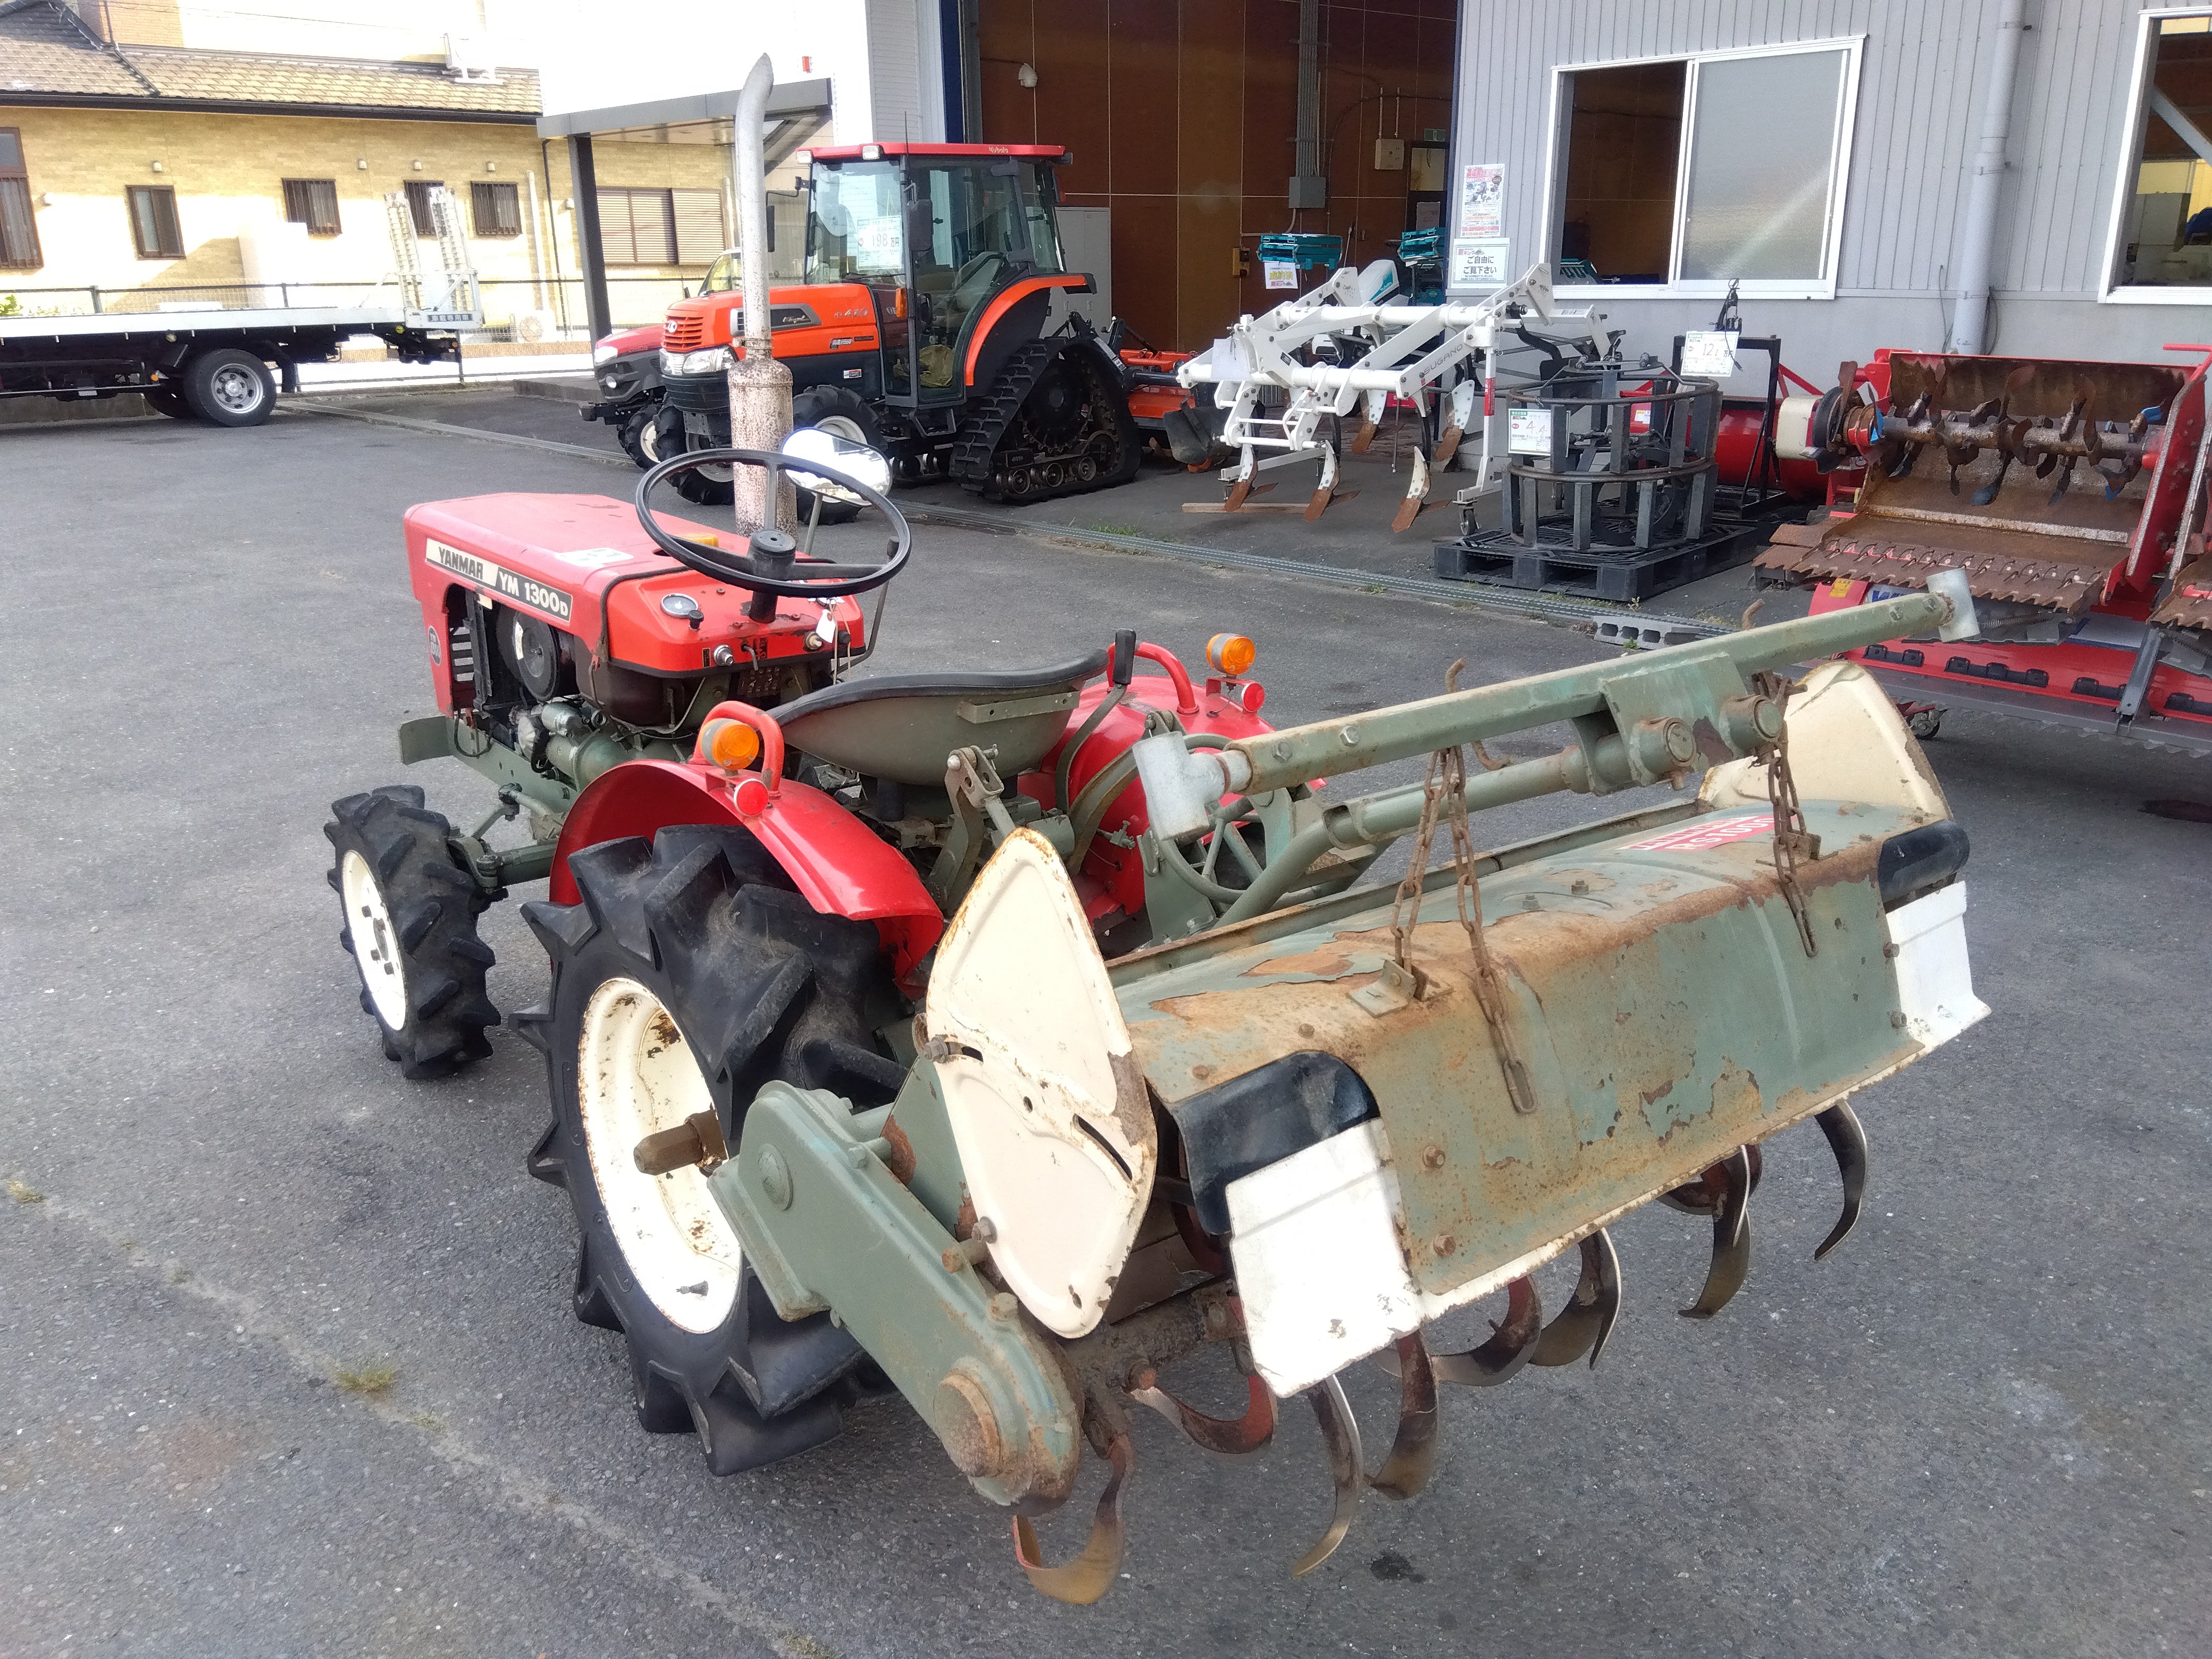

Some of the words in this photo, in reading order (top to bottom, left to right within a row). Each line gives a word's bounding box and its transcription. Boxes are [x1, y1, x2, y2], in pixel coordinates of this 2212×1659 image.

[1463, 266, 1497, 274] ご覧下さい
[1424, 343, 1463, 375] SUGANO
[439, 546, 483, 581] YANMAR
[499, 571, 520, 597] YM
[524, 582, 568, 617] 1300D
